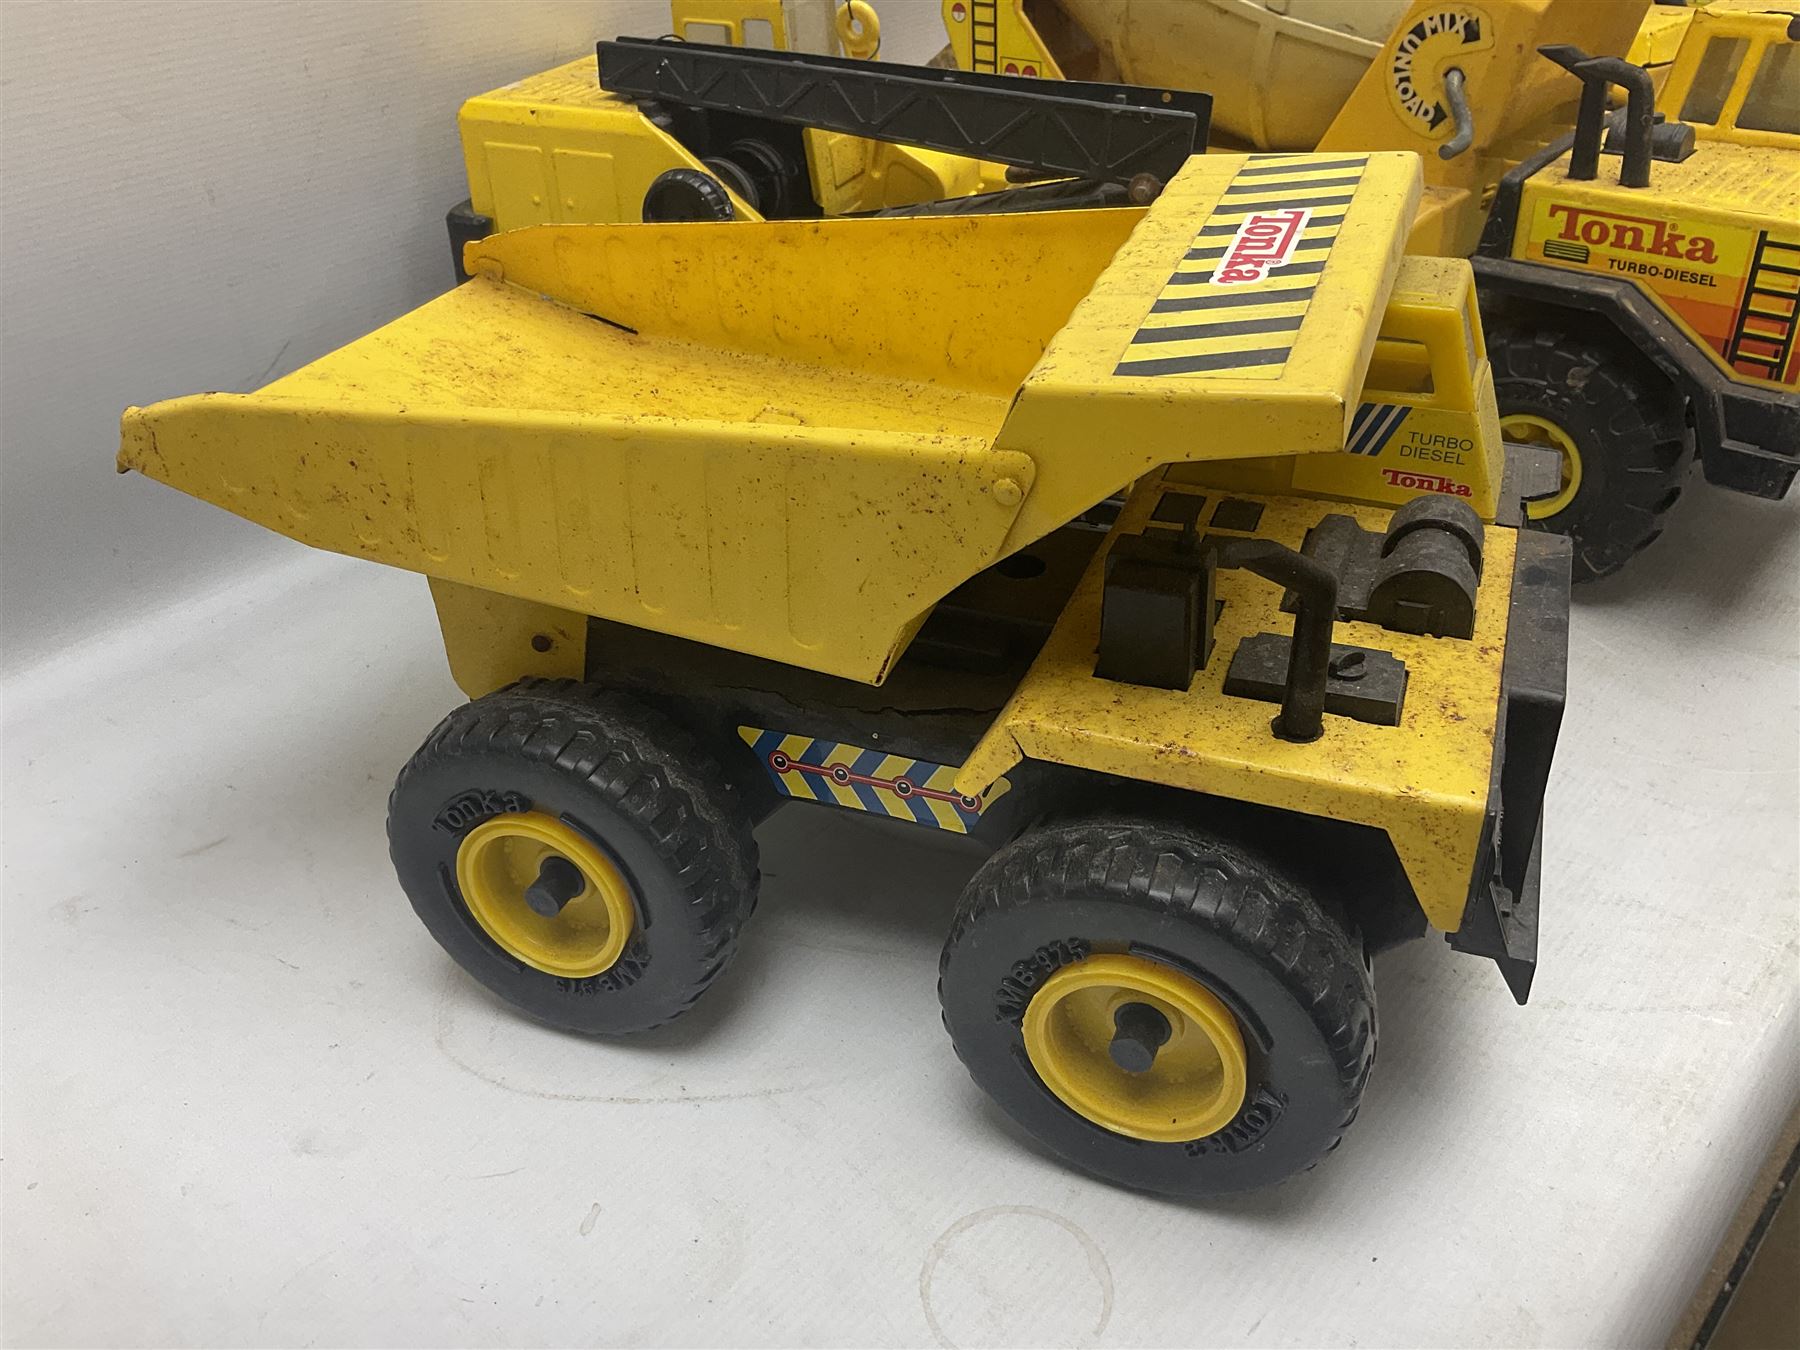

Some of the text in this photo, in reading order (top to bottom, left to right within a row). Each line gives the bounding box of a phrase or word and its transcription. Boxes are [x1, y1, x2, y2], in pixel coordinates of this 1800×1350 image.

[1422, 13, 1470, 40] MIX
[1394, 33, 1435, 122] UNLOAD
[1217, 210, 1305, 284] Tonka
[1549, 204, 1719, 265] Tonka
[1608, 258, 1717, 288] TURBO-DIESEL
[1400, 445, 1465, 466] DIESEL
[1409, 431, 1474, 452] TURBO
[1382, 468, 1473, 498] Tonka
